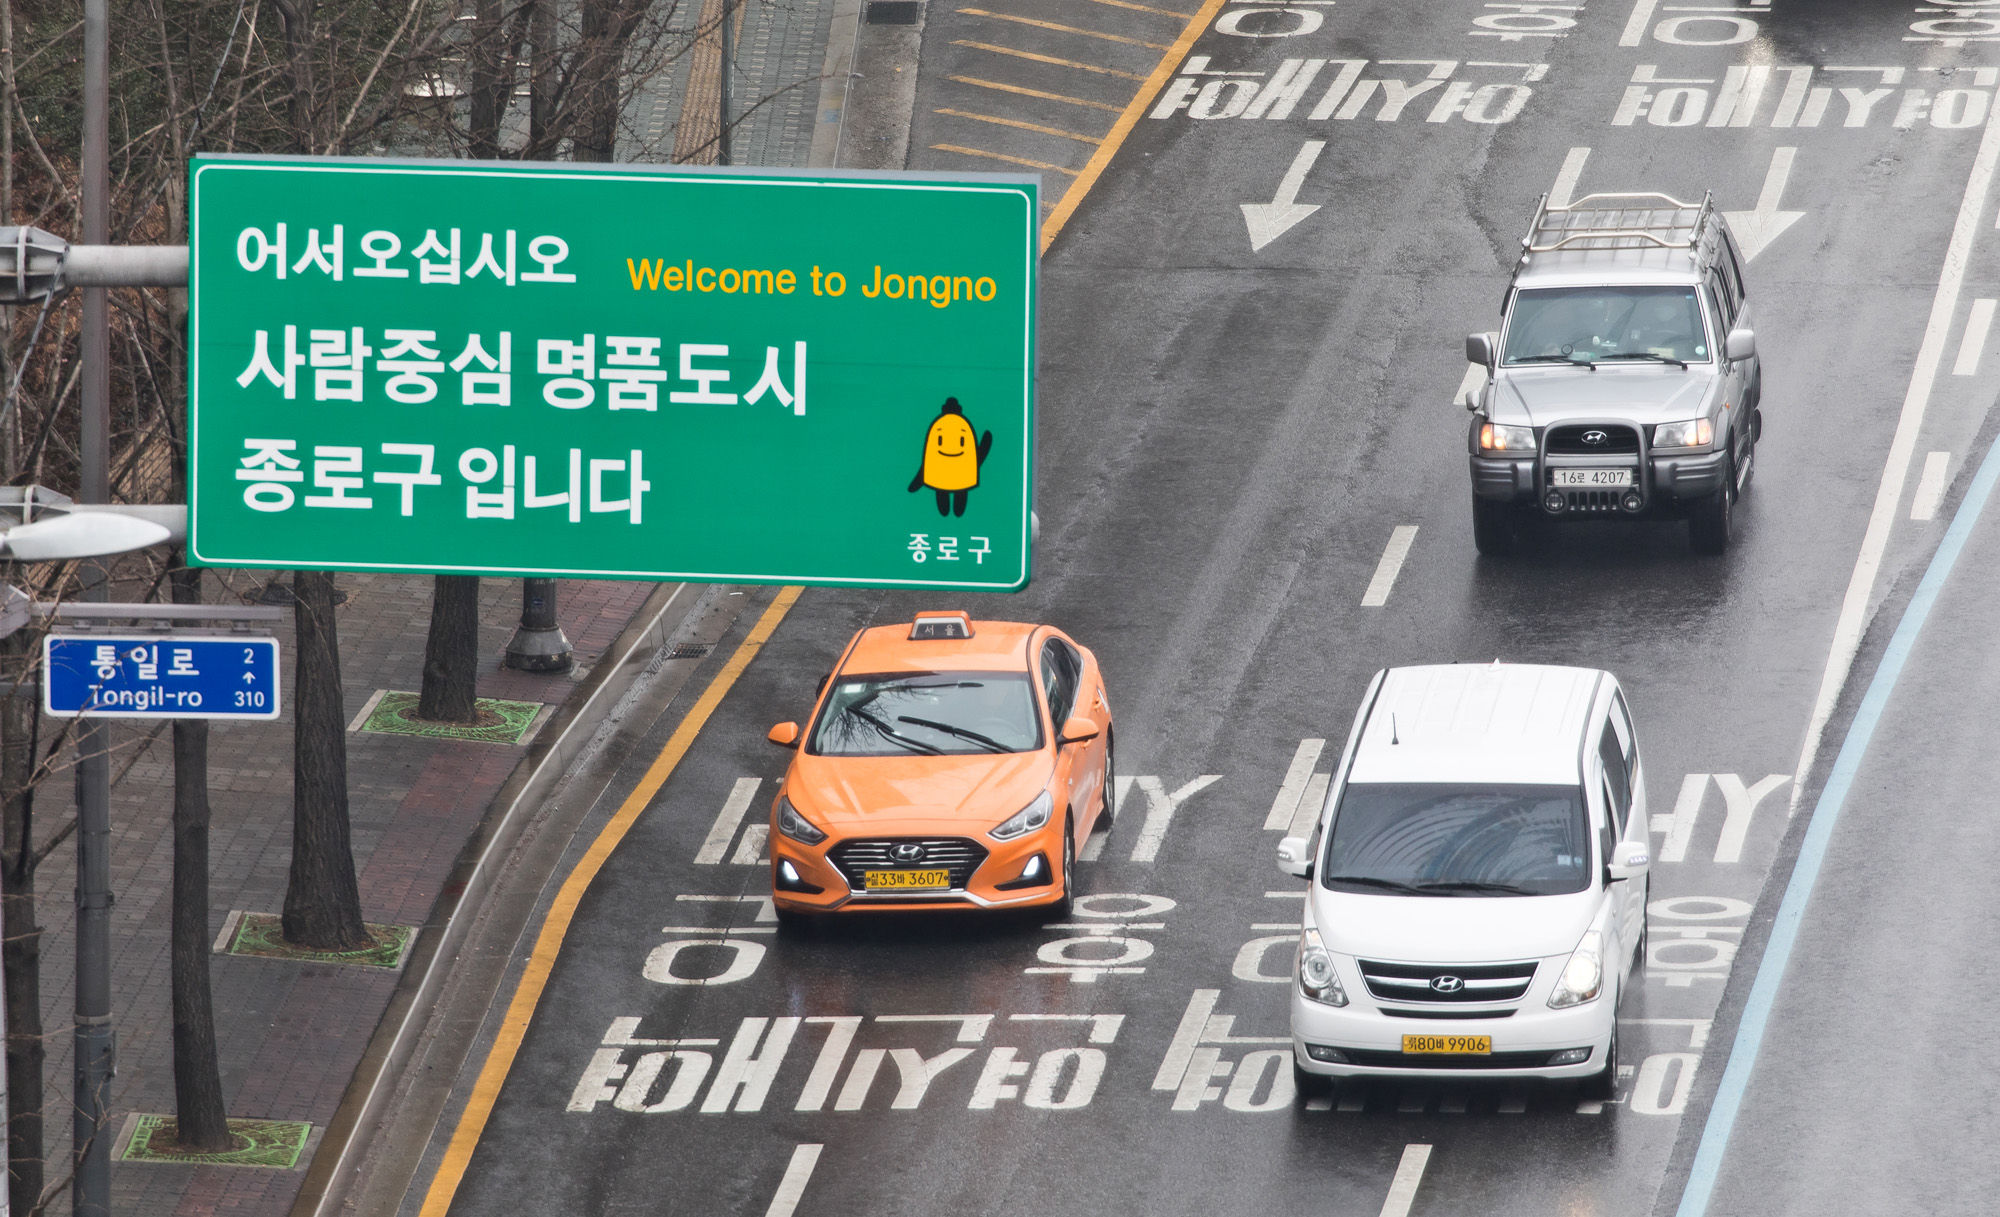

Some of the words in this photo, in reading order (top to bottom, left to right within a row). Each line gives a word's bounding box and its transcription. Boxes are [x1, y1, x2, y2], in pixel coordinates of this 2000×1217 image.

[236, 222, 577, 287] 어서오십시오
[627, 258, 797, 295] Welcome
[810, 265, 847, 297] to
[861, 265, 997, 309] Jongno
[236, 324, 512, 407] 사람중심
[537, 333, 808, 416] 명품도시
[235, 437, 442, 517] 종로구
[457, 444, 652, 525] 입니다
[1561, 471, 1585, 484] 16로
[1591, 471, 1625, 484] 4207
[907, 533, 993, 565] 종로구
[924, 624, 956, 636] 서울
[90, 645, 200, 681] 통일로
[243, 648, 254, 664] 2
[88, 684, 203, 711] Tongil-ro
[234, 690, 265, 708] 310
[908, 871, 944, 885] 3607
[1448, 1037, 1485, 1051] 9906
